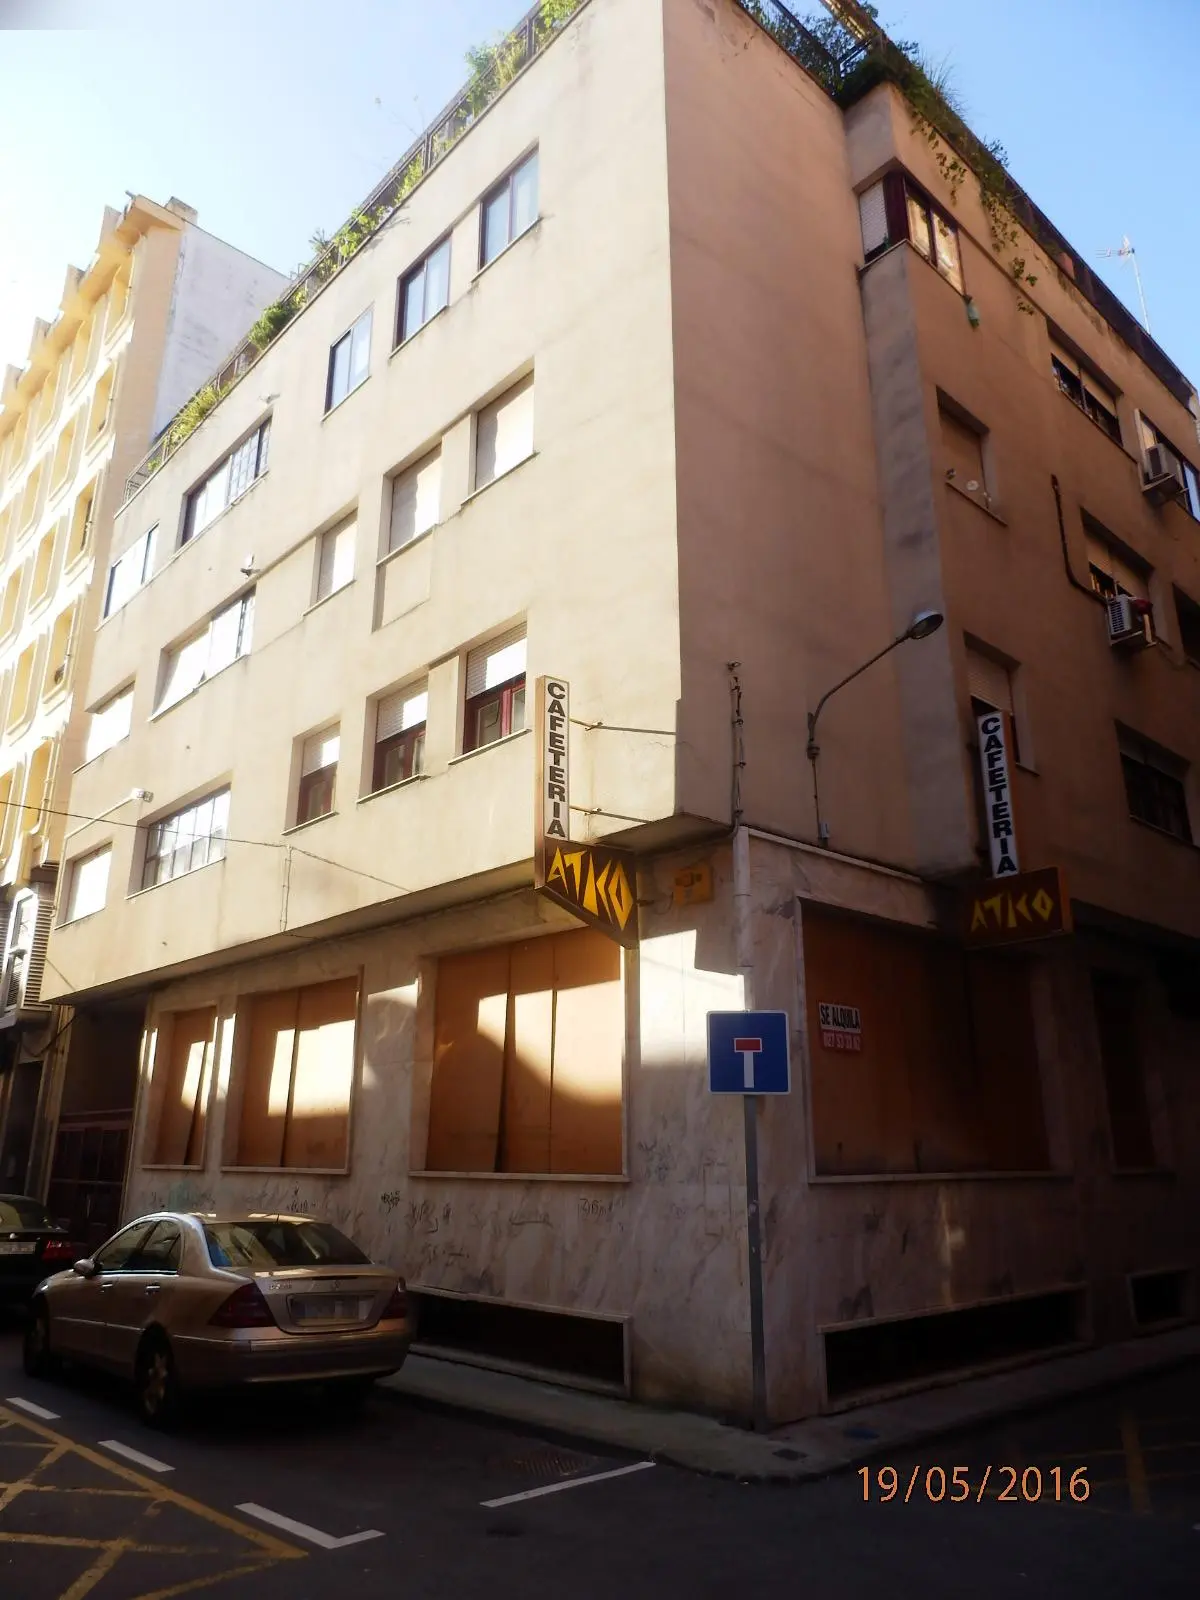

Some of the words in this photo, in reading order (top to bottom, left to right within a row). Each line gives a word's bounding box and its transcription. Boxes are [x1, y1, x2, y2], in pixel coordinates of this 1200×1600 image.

[547, 682, 566, 838] CAFETERIA
[981, 716, 1018, 875] CAFETERIA
[820, 1005, 830, 1025] SE
[832, 1006, 860, 1029] ALQUILA
